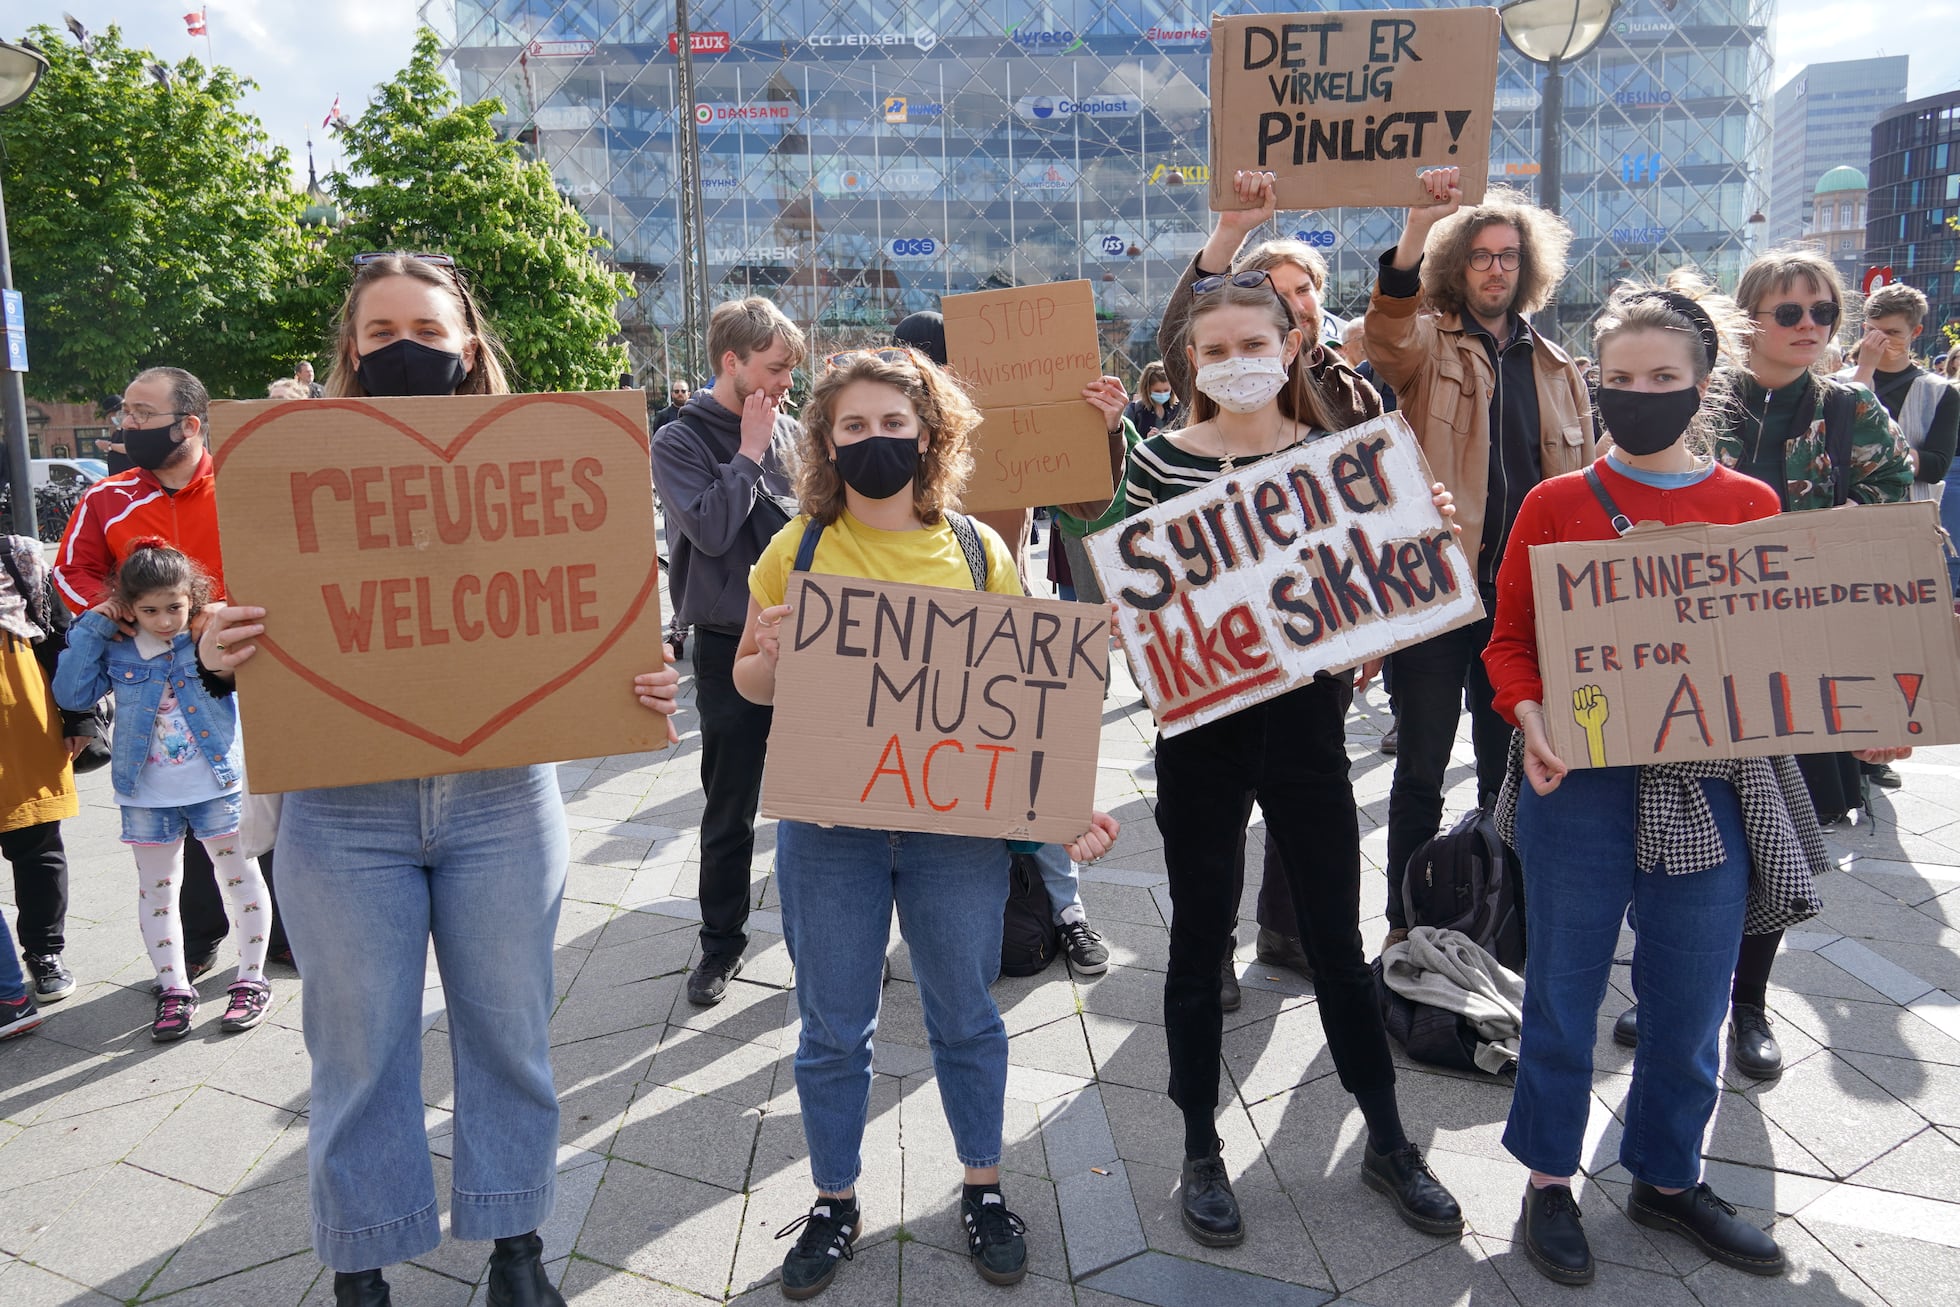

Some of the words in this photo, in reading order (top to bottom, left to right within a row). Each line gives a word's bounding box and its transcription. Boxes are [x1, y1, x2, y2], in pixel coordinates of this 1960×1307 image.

[807, 35, 832, 46] CG
[1013, 29, 1073, 44] Lyreco
[1147, 28, 1208, 41] Elworks
[1629, 23, 1675, 34] JULIANA
[1244, 22, 1343, 70] DET
[1369, 19, 1422, 63] ER
[717, 107, 789, 119] DANSAND
[1059, 101, 1127, 114] Coloplast
[1615, 91, 1671, 105] RESINO
[895, 241, 933, 252] JKS
[1614, 228, 1666, 243] NKT
[979, 297, 1055, 345] STOP
[1012, 408, 1041, 435] til
[995, 449, 1071, 494] Syrien
[1118, 438, 1391, 611] Syriener
[321, 564, 599, 654] WELCOME
[1676, 579, 1937, 623] RETTIGHEDERNE
[794, 579, 1106, 681] DENMARK
[1139, 592, 1268, 701] ikke
[1575, 645, 1623, 673] ER
[1633, 642, 1690, 669] FOR
[866, 662, 1067, 740] MUST
[1653, 671, 1924, 753] ALLE!
